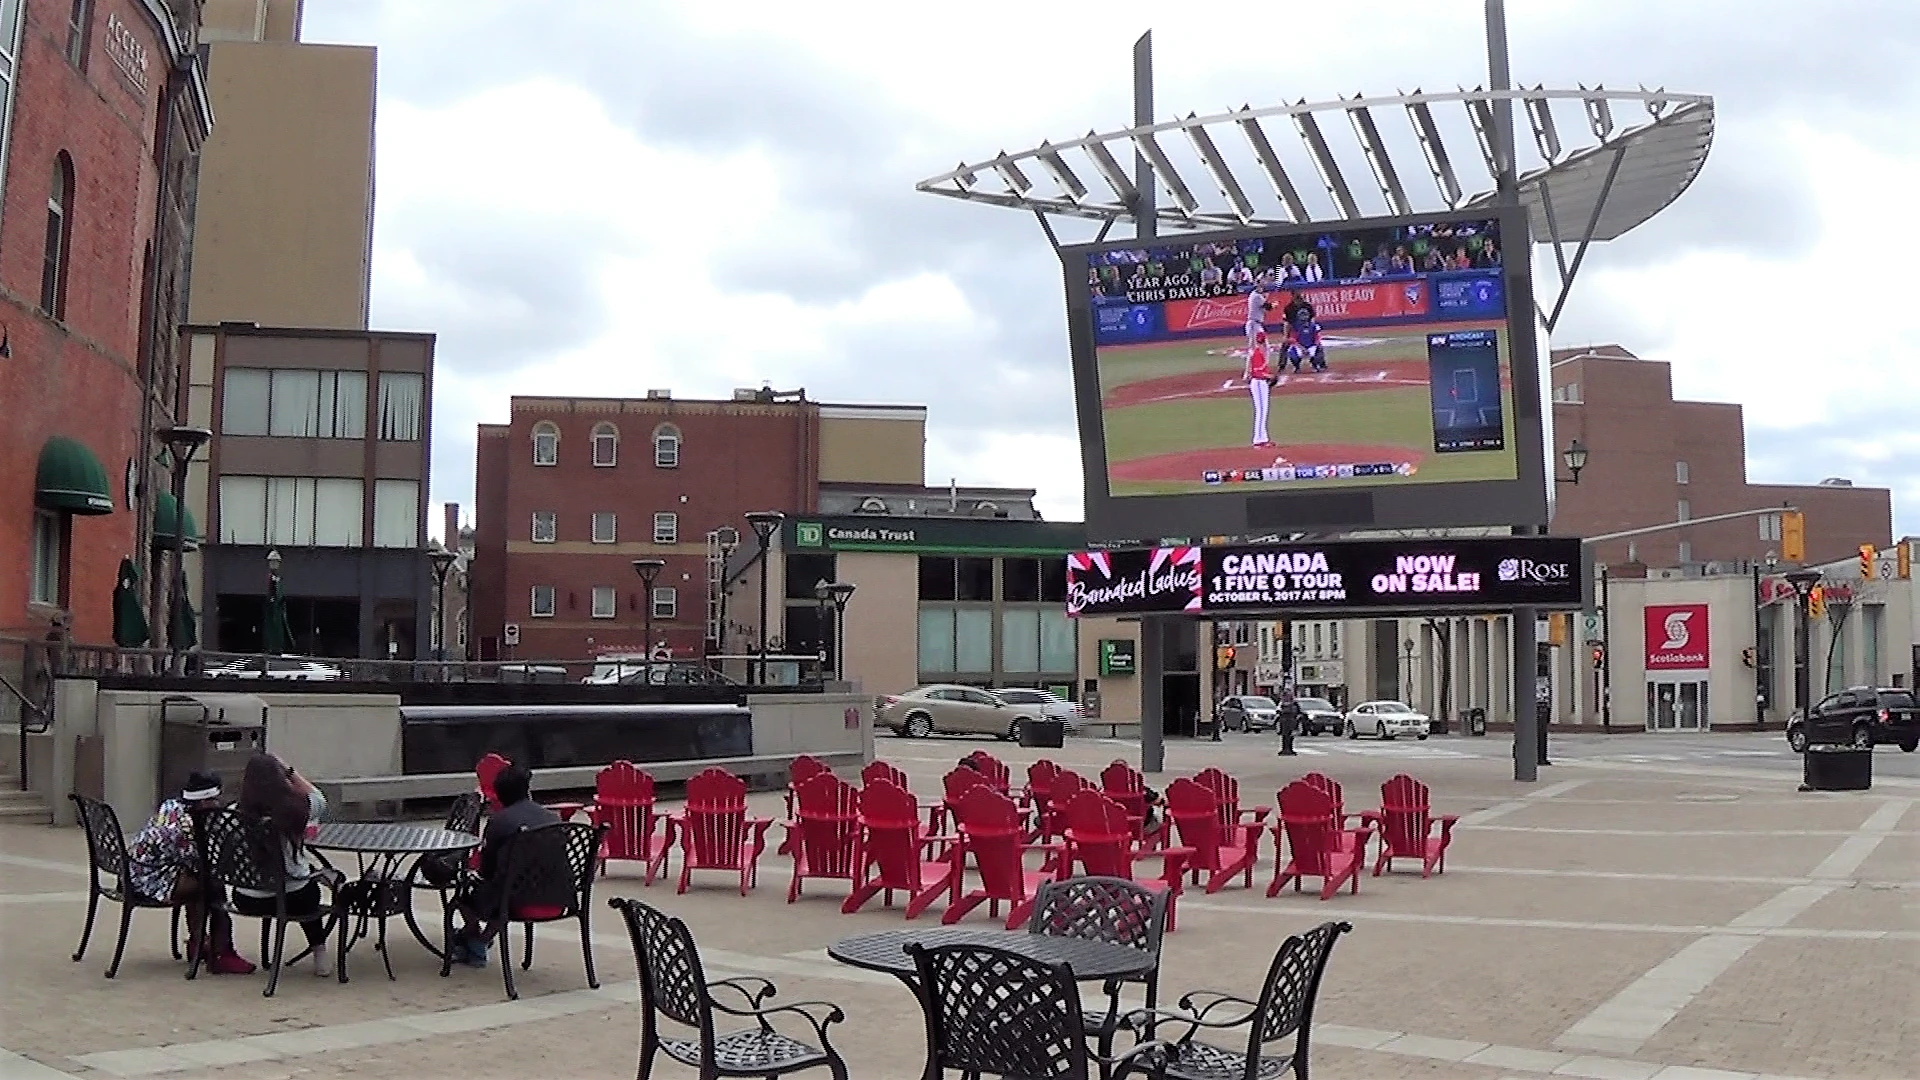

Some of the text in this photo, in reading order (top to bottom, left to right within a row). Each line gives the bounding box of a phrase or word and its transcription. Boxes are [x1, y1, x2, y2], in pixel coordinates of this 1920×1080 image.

[1127, 277, 1160, 290] YEAR
[1127, 290, 1165, 303] CHRIS
[1169, 286, 1210, 299] DAVIS,
[1340, 288, 1375, 302] READY
[828, 527, 915, 541] Canada Trust
[1222, 552, 1329, 575] CANADA
[1396, 555, 1456, 575] NOW
[1072, 564, 1198, 612] Barenaked Ladies
[1211, 575, 1222, 591] 1
[1225, 574, 1270, 590] FIVE
[1290, 572, 1343, 589] TOUR
[1371, 572, 1481, 593] ON SALE!
[1208, 592, 1261, 603] OCTOBER
[1274, 590, 1301, 601] 2017
[1302, 590, 1316, 600] AT
[1649, 653, 1704, 663] Scotiabank
